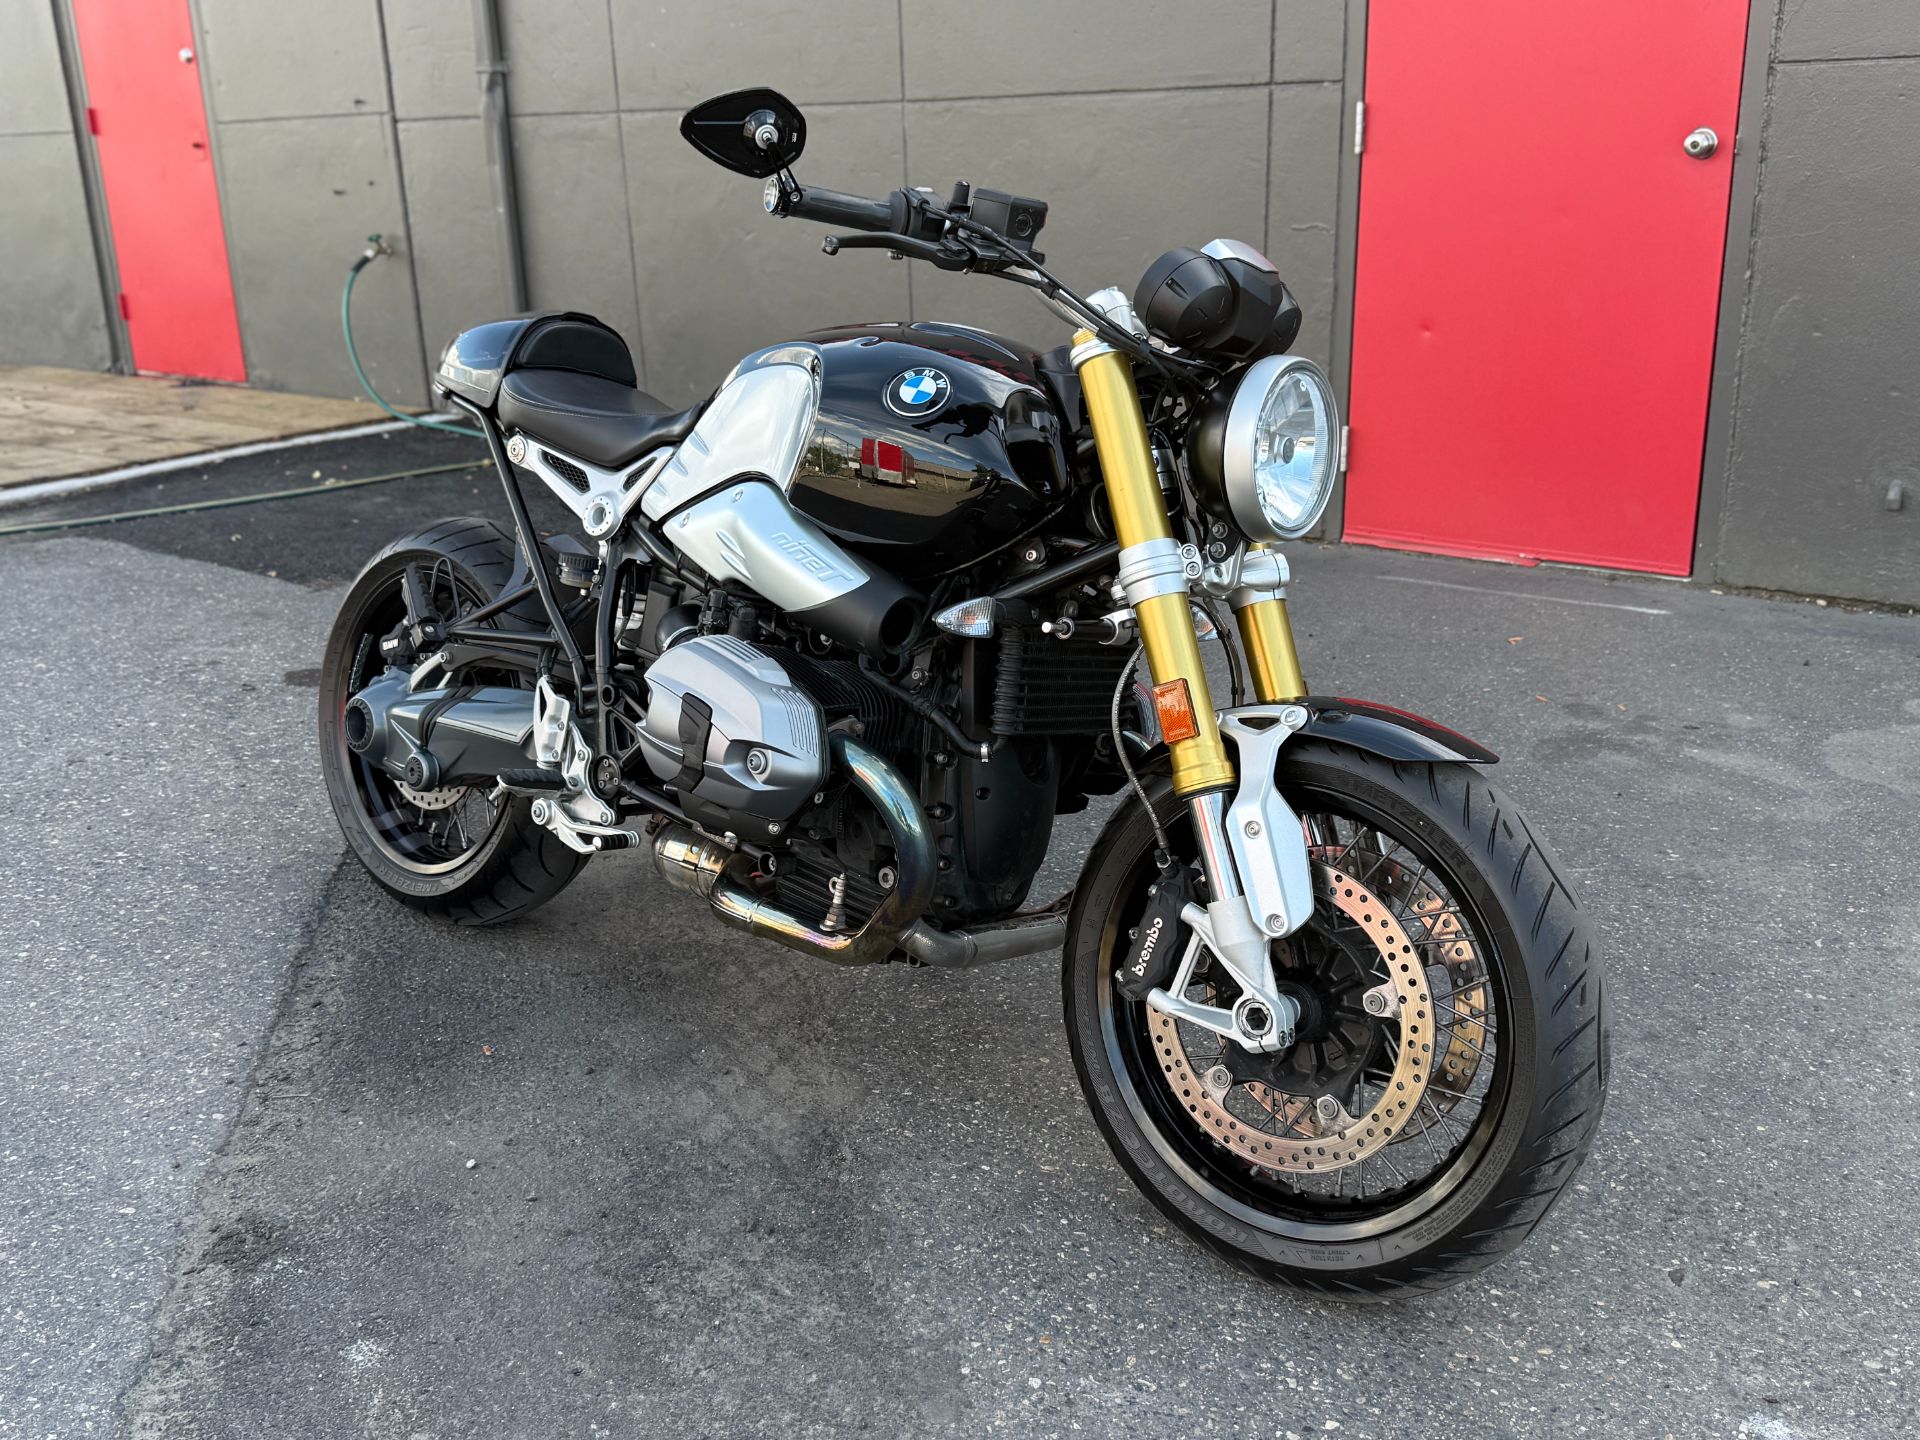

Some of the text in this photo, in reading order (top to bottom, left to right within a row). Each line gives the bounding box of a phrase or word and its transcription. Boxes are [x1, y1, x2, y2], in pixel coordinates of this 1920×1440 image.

[903, 369, 947, 388] BMW
[382, 638, 399, 651] BMW
[1131, 917, 1163, 977] brembo
